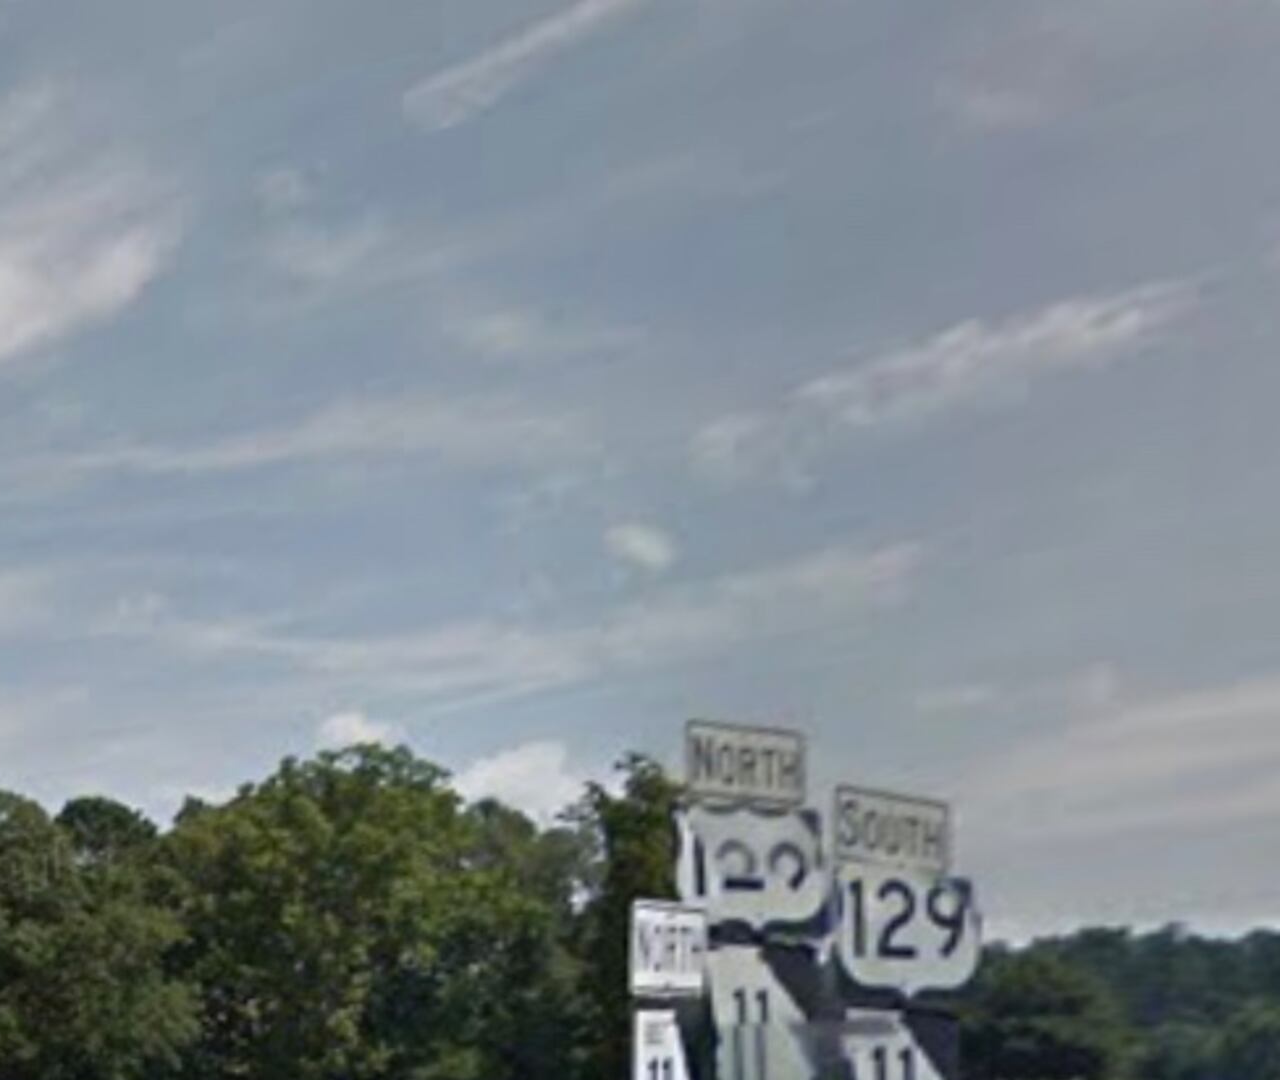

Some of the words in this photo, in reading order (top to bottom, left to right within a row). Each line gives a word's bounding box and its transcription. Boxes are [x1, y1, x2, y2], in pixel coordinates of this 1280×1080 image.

[689, 735, 801, 790] NORTH
[840, 798, 940, 860] SOUTH
[849, 878, 972, 960] 129
